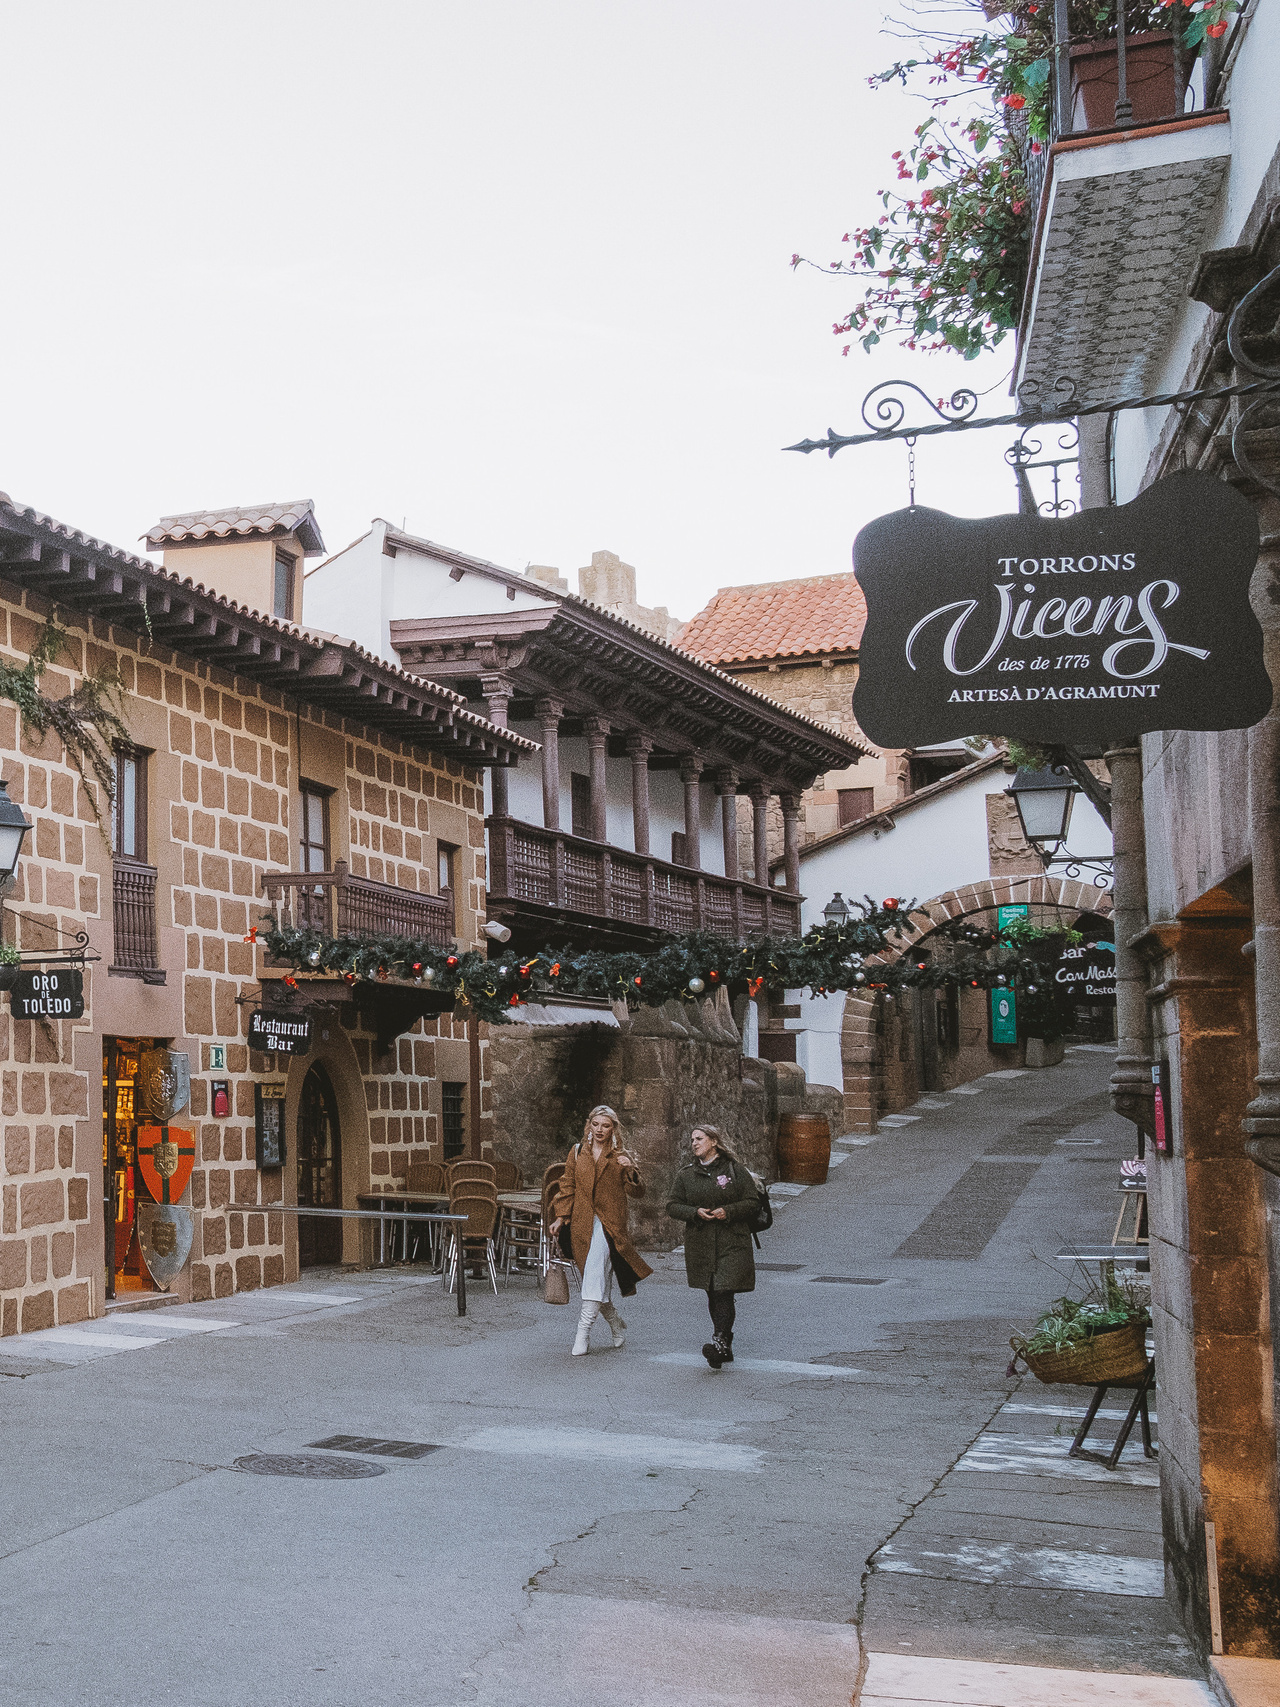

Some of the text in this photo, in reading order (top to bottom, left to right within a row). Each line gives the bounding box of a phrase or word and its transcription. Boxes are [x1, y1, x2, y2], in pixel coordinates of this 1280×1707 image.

[998, 553, 1136, 577] TORRONS
[905, 579, 1211, 680] Vicens
[998, 654, 1090, 672] des de 1775
[947, 684, 1160, 703] ARTESÀ D'AGRAMUNT
[1084, 965, 1117, 981] Mass
[32, 975, 58, 991] ORO
[41, 991, 50, 999] DE
[22, 998, 71, 1014] TOLEDO
[253, 1014, 309, 1037] Restaurant
[266, 1035, 295, 1051] Bar
